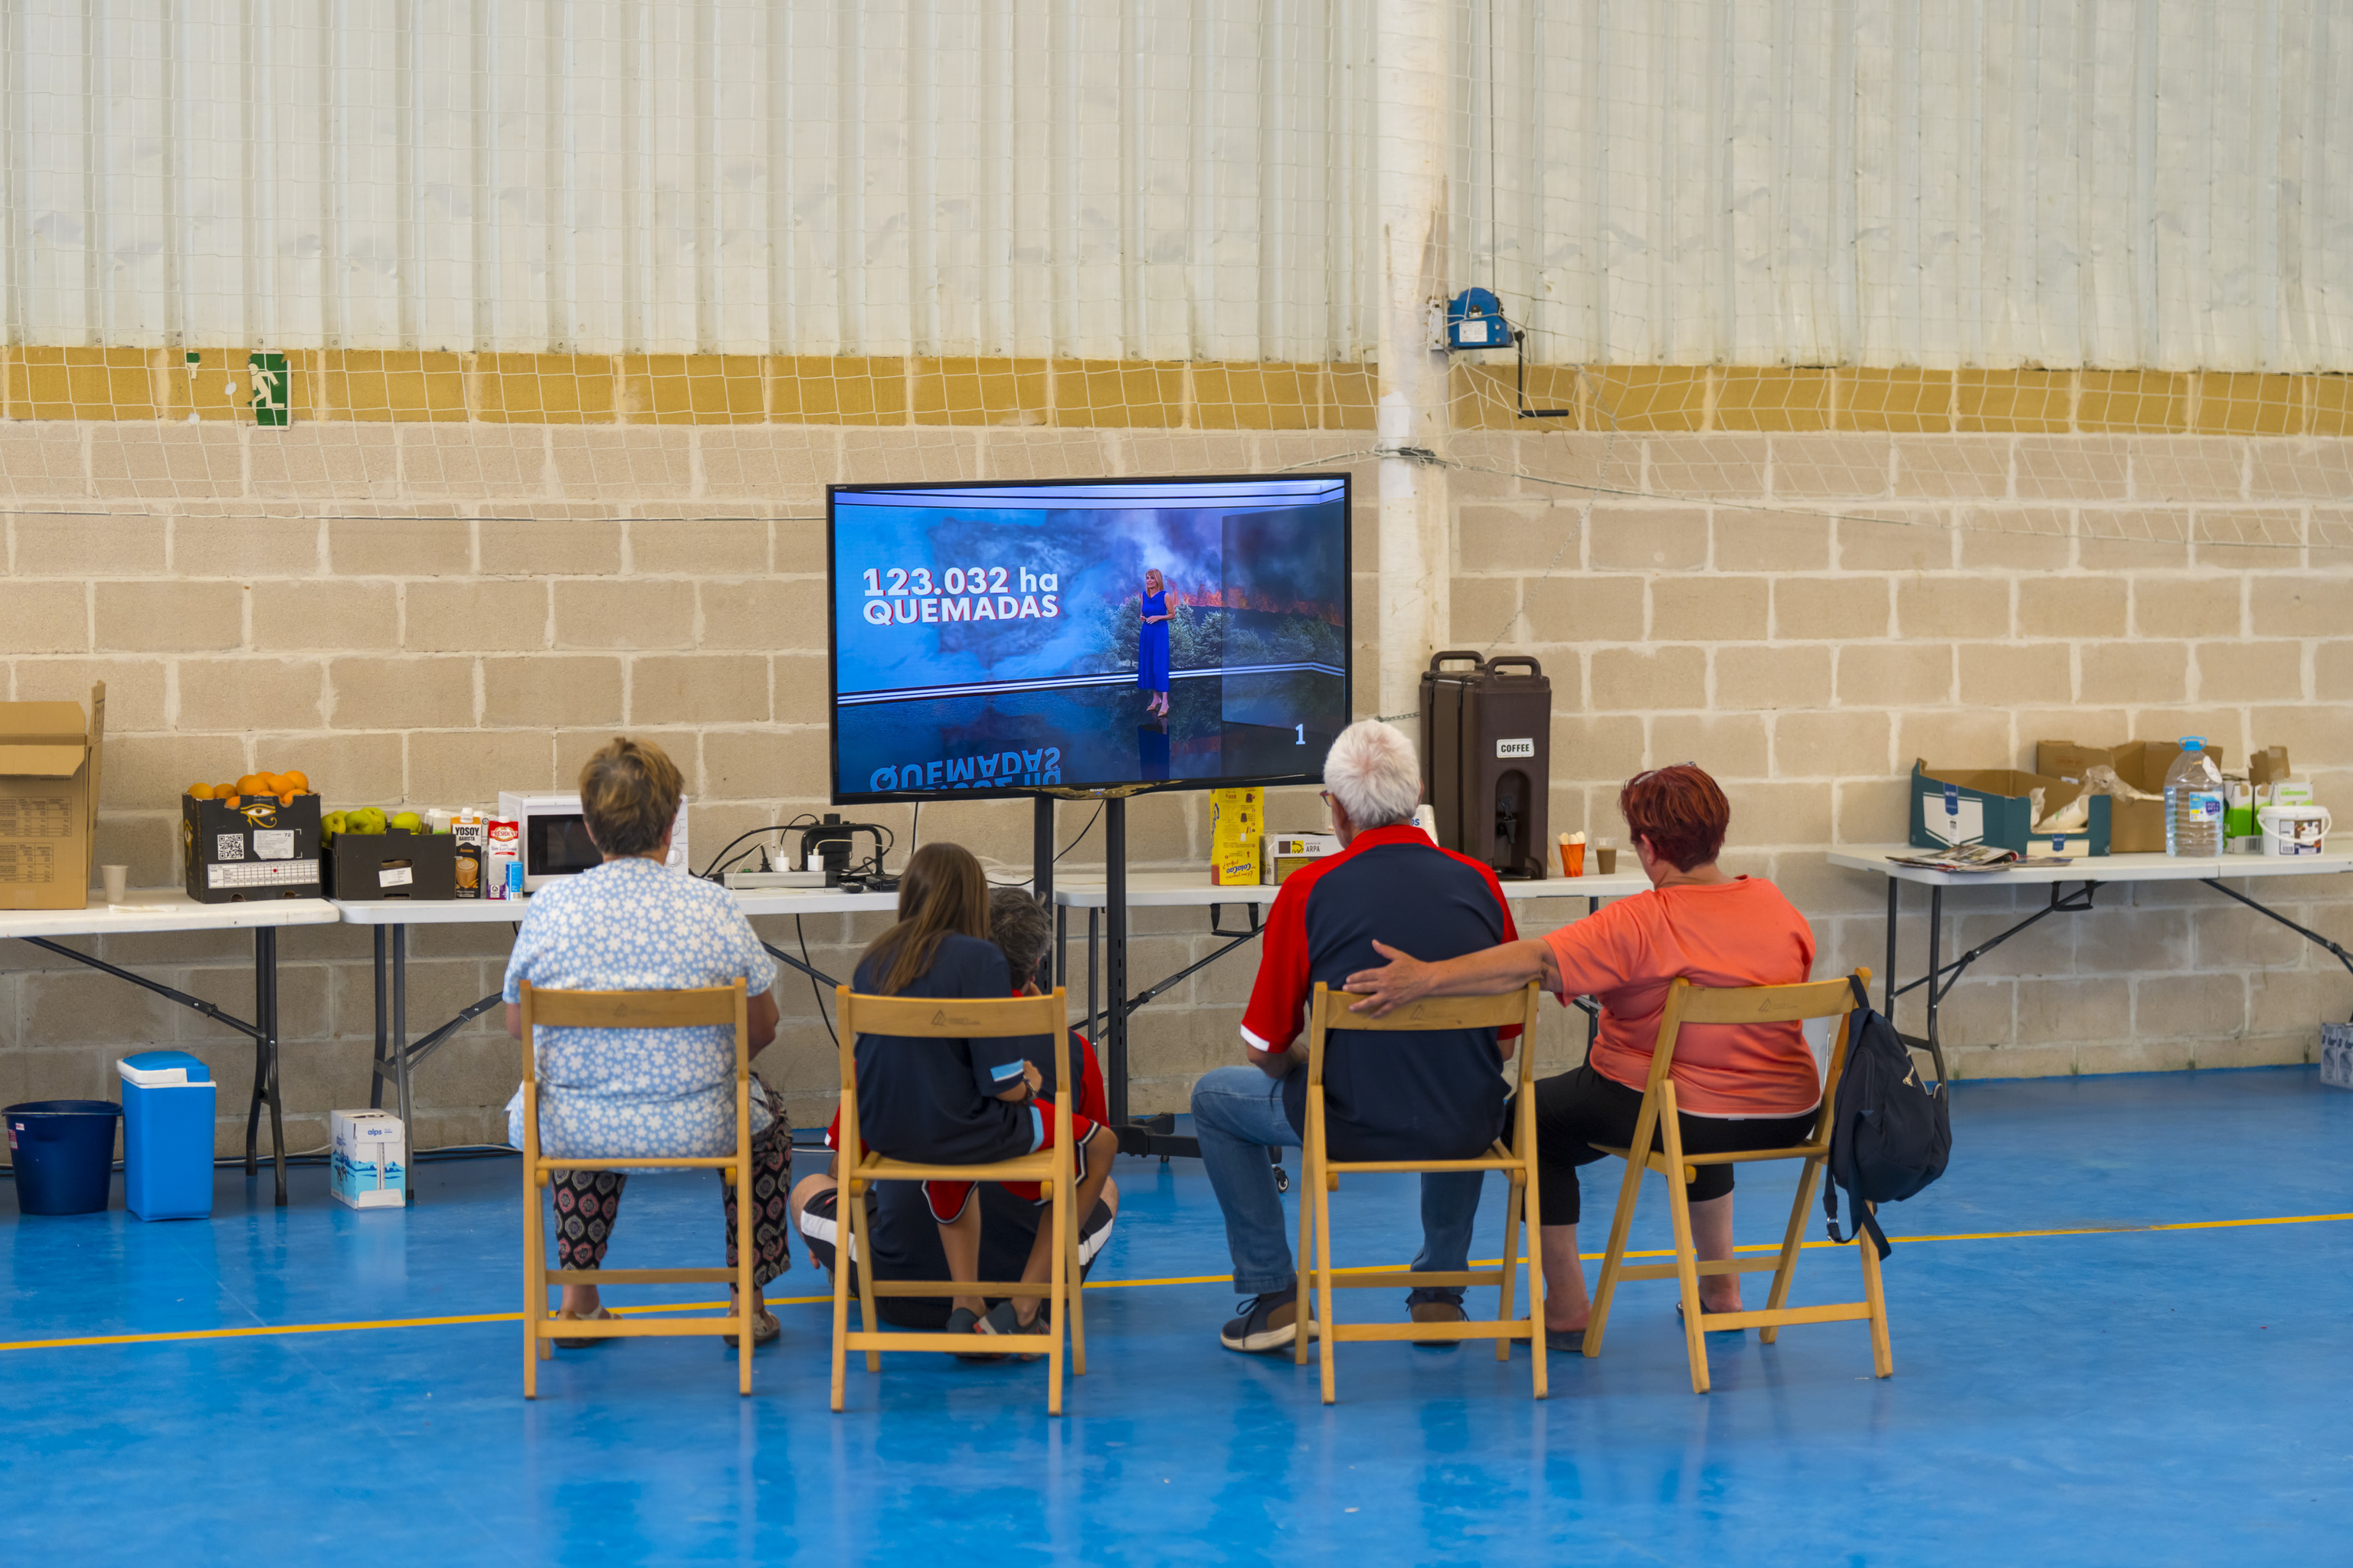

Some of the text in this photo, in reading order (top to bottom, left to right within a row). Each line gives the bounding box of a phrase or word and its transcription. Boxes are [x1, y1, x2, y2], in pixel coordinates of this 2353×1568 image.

[862, 566, 1059, 596] 123.032 ha
[862, 594, 1059, 626] QUEMADAS
[1294, 723, 1306, 745] 1
[1500, 744, 1530, 752] COFFEE
[456, 827, 479, 836] YOSOY
[1226, 863, 1251, 874] ColaCao
[368, 1128, 382, 1137] alps
